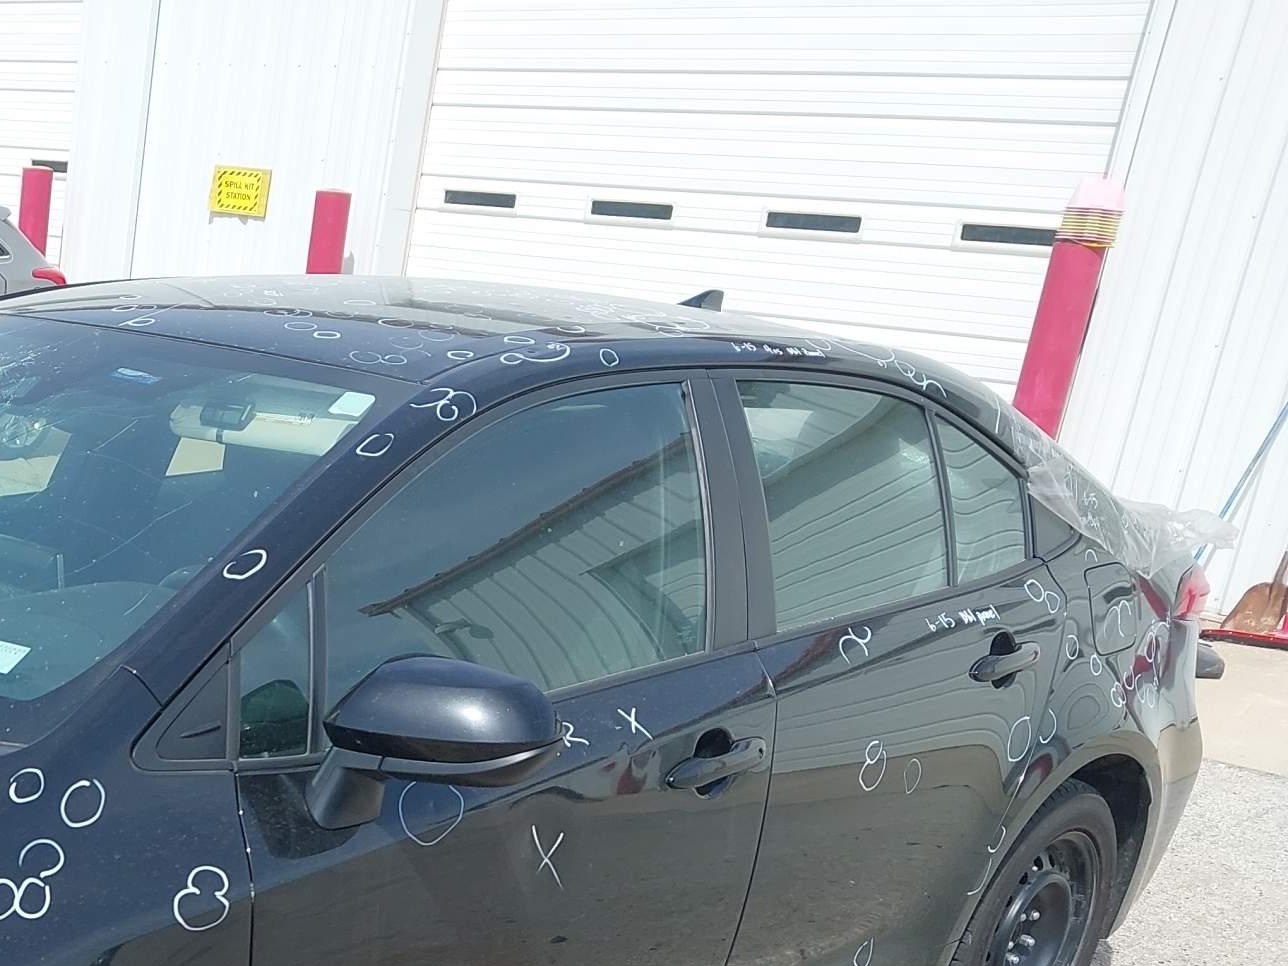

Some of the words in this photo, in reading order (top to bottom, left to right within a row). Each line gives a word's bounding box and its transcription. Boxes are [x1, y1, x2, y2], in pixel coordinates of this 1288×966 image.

[224, 180, 242, 190] SPILL
[244, 182, 255, 191] KIT
[225, 191, 251, 201] STATION
[924, 612, 956, 632] 6-15
